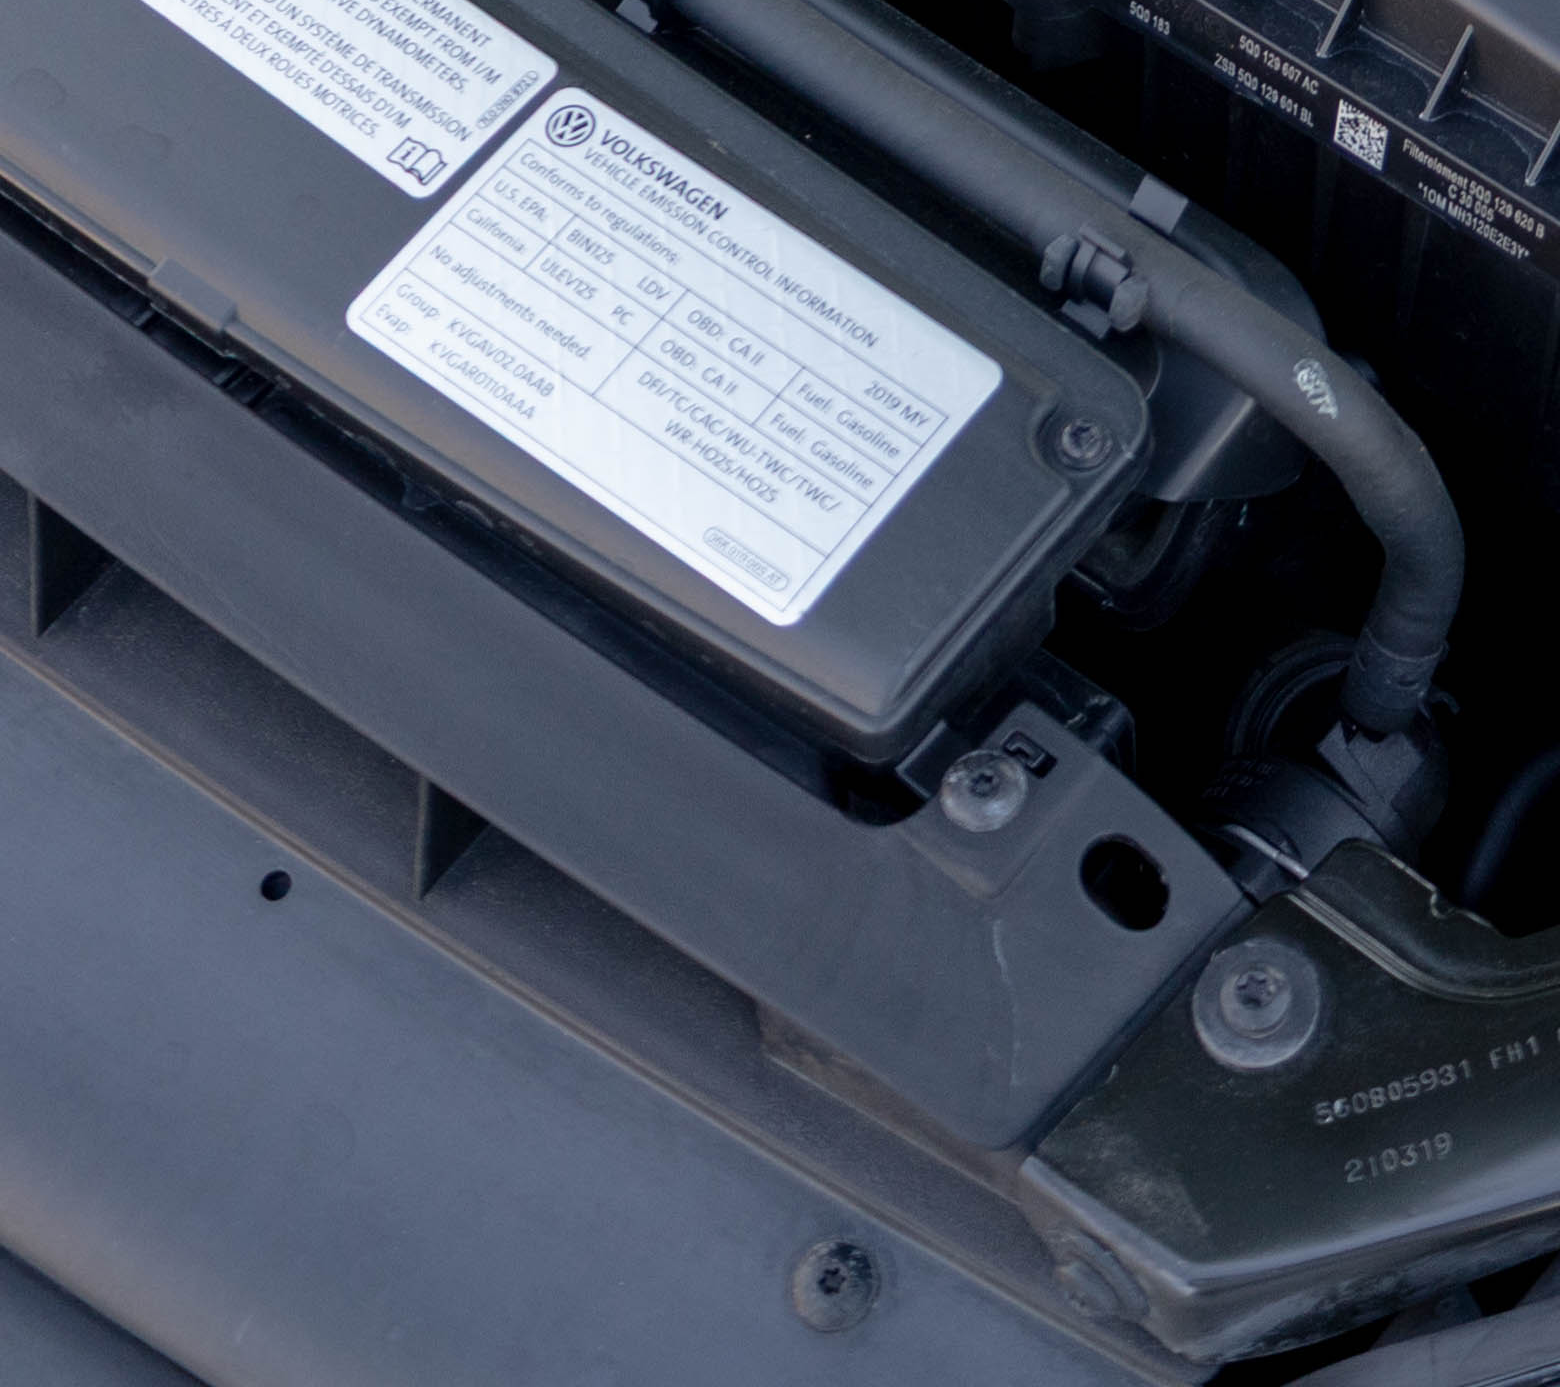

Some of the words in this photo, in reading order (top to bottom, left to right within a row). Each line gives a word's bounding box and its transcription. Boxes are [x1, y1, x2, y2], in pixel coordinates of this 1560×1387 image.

[296, 13, 357, 59] SYSTÈME
[350, 52, 377, 74] DE
[372, 66, 472, 142] TRANSMISSION
[354, 7, 468, 91] DYNAMOMETERS.
[432, 33, 477, 67] FROM
[472, 61, 502, 85] I/M
[1263, 50, 1281, 71] 129
[1303, 76, 1319, 95] AC
[599, 129, 728, 221] VOLKSWAGEN
[1402, 137, 1468, 190] Filterelement
[465, 207, 526, 253] California:
[492, 178, 520, 203] U.S.
[517, 195, 547, 222] EPA:
[519, 151, 585, 201] Conforms
[583, 193, 603, 212] to
[599, 206, 679, 264] regulations:
[565, 228, 615, 265] BIN125
[635, 275, 670, 301] LDV
[582, 146, 641, 191] VEHICLE
[637, 184, 709, 236] EMISSION
[705, 229, 774, 280] CONTROL
[774, 274, 878, 348] INFORMATION
[429, 244, 453, 266] No
[449, 262, 536, 323] adjustments
[534, 318, 592, 359] needed.
[539, 257, 598, 300] ULEV125
[610, 304, 634, 326] PC
[659, 338, 697, 368] OBD:
[700, 366, 725, 388] CA
[722, 380, 739, 396] II
[686, 308, 724, 338] OBD:
[727, 336, 752, 358] CA
[748, 350, 765, 366] II
[796, 382, 833, 411] Fuel:
[835, 409, 901, 458] Gasoline
[863, 381, 902, 411] 2019
[898, 403, 929, 427] MY
[769, 412, 806, 444] Fuel:
[809, 439, 874, 489] Gasoline
[1343, 1130, 1454, 1185] 210319
